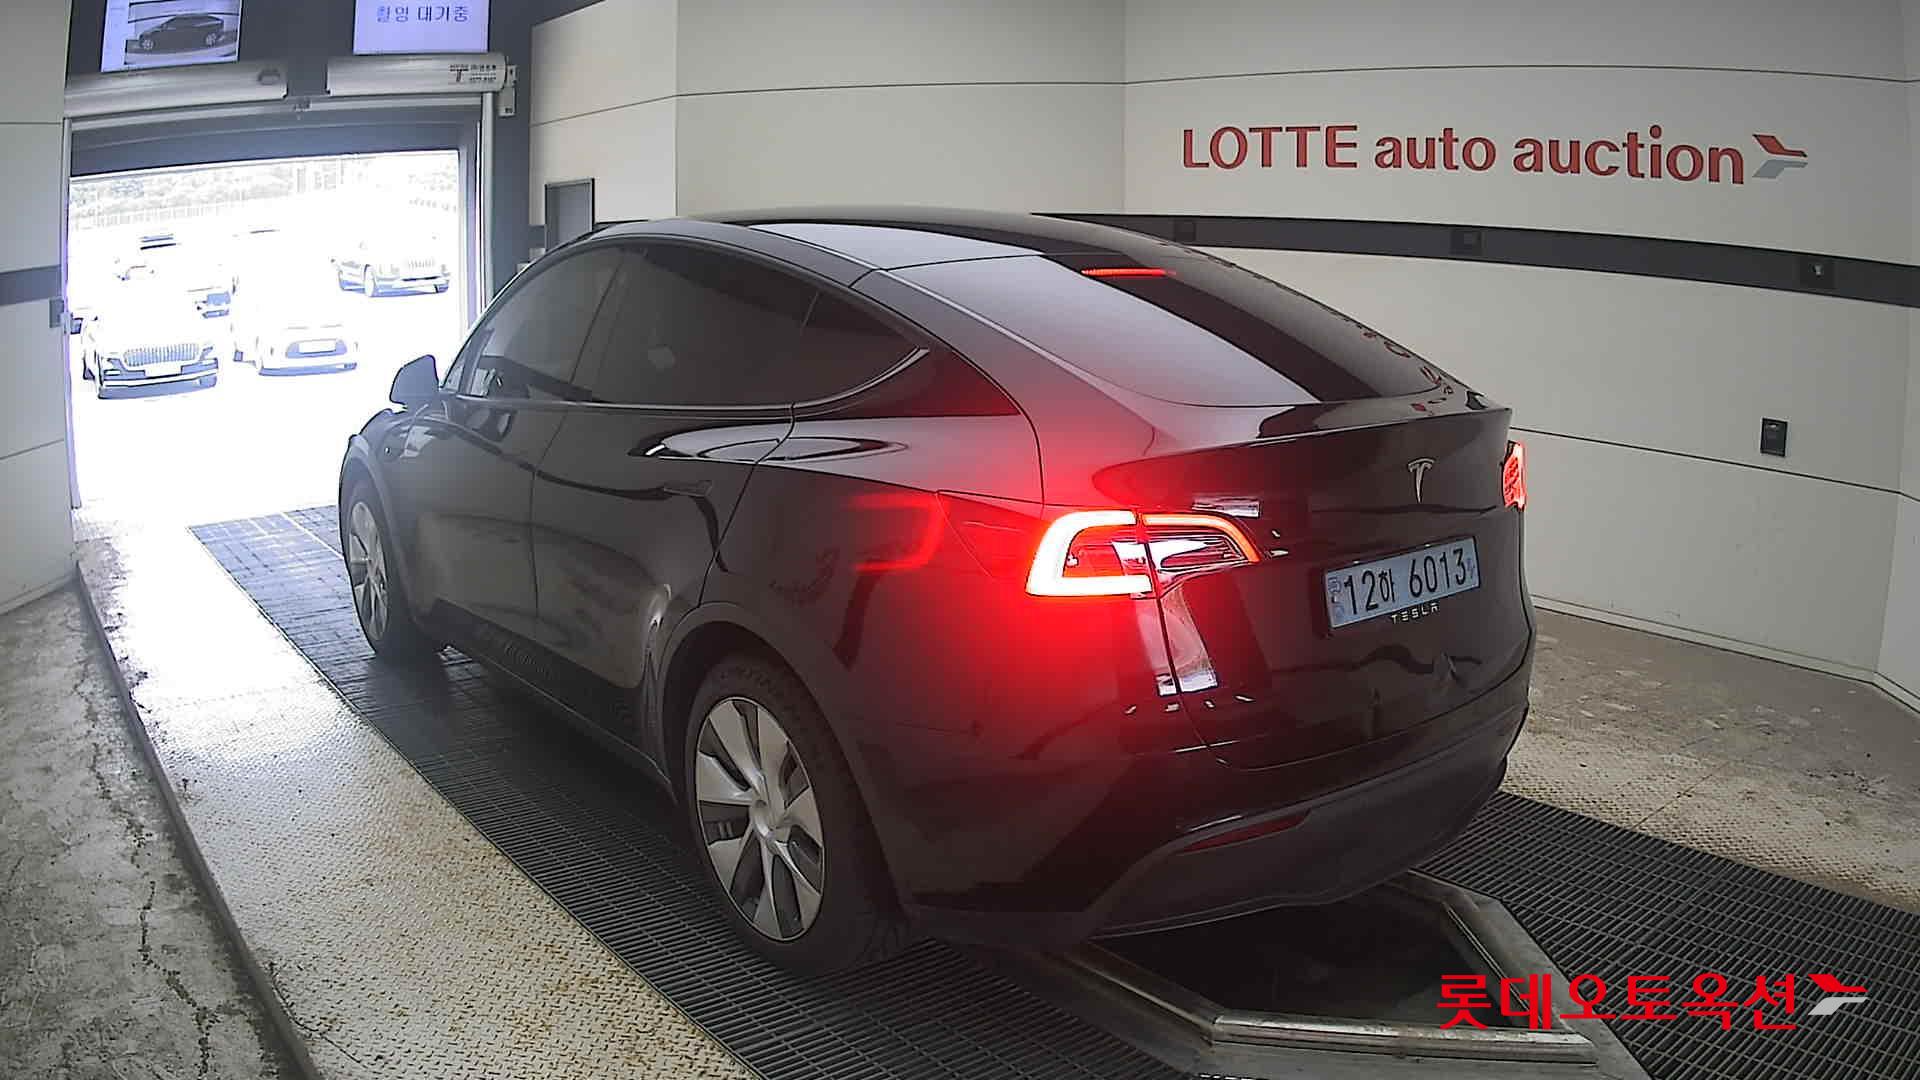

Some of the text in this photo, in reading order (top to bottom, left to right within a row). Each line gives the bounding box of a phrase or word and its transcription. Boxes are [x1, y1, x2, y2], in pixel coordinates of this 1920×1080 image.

[416, 5, 469, 23] 대기중
[1183, 124, 1746, 185] LOTTE auto auction
[1343, 568, 1396, 615] 12하
[1408, 547, 1467, 598] 6013
[1391, 602, 1440, 625] TESLA
